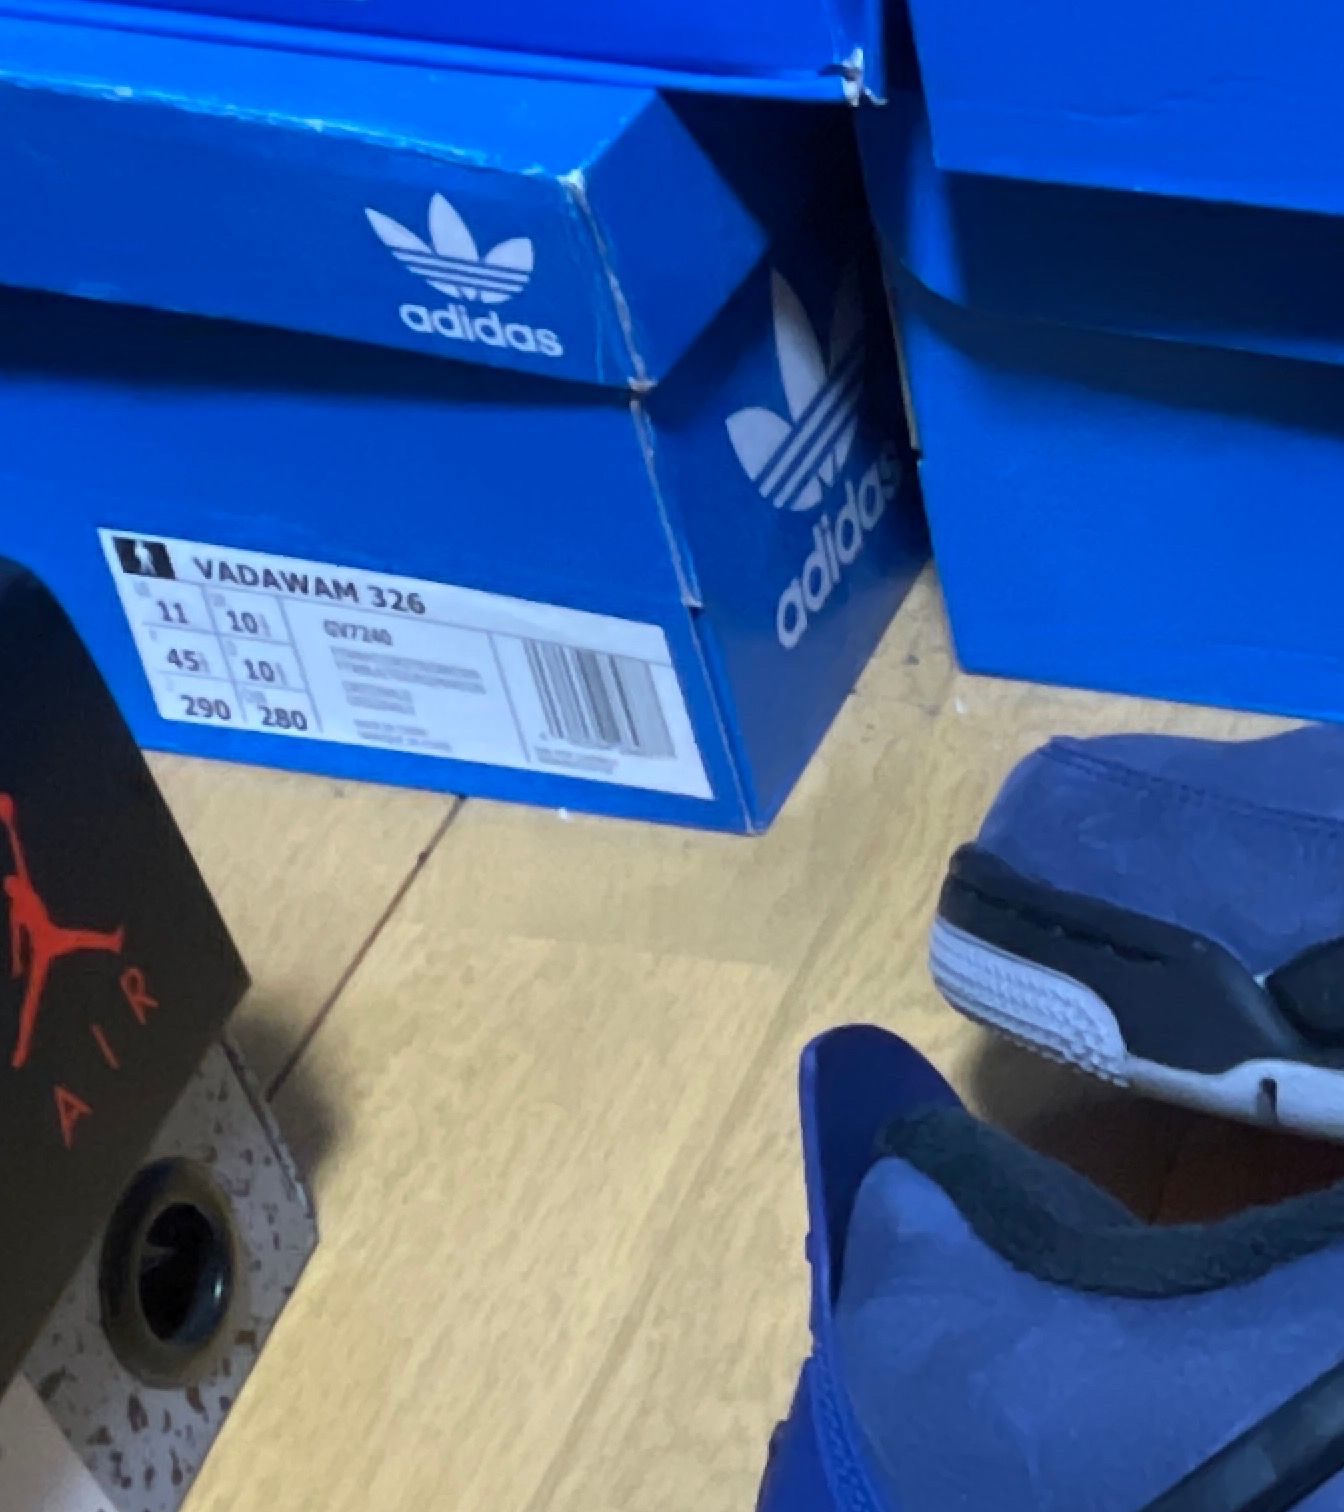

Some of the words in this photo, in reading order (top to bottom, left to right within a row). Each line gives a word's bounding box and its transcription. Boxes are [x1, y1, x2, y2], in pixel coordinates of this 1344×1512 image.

[399, 303, 565, 358] adidas
[776, 445, 898, 650] adidas
[192, 556, 360, 604] VADAWAM
[367, 585, 427, 616] 326
[156, 600, 189, 624] 11
[181, 694, 231, 720] 290
[257, 705, 308, 731] 280
